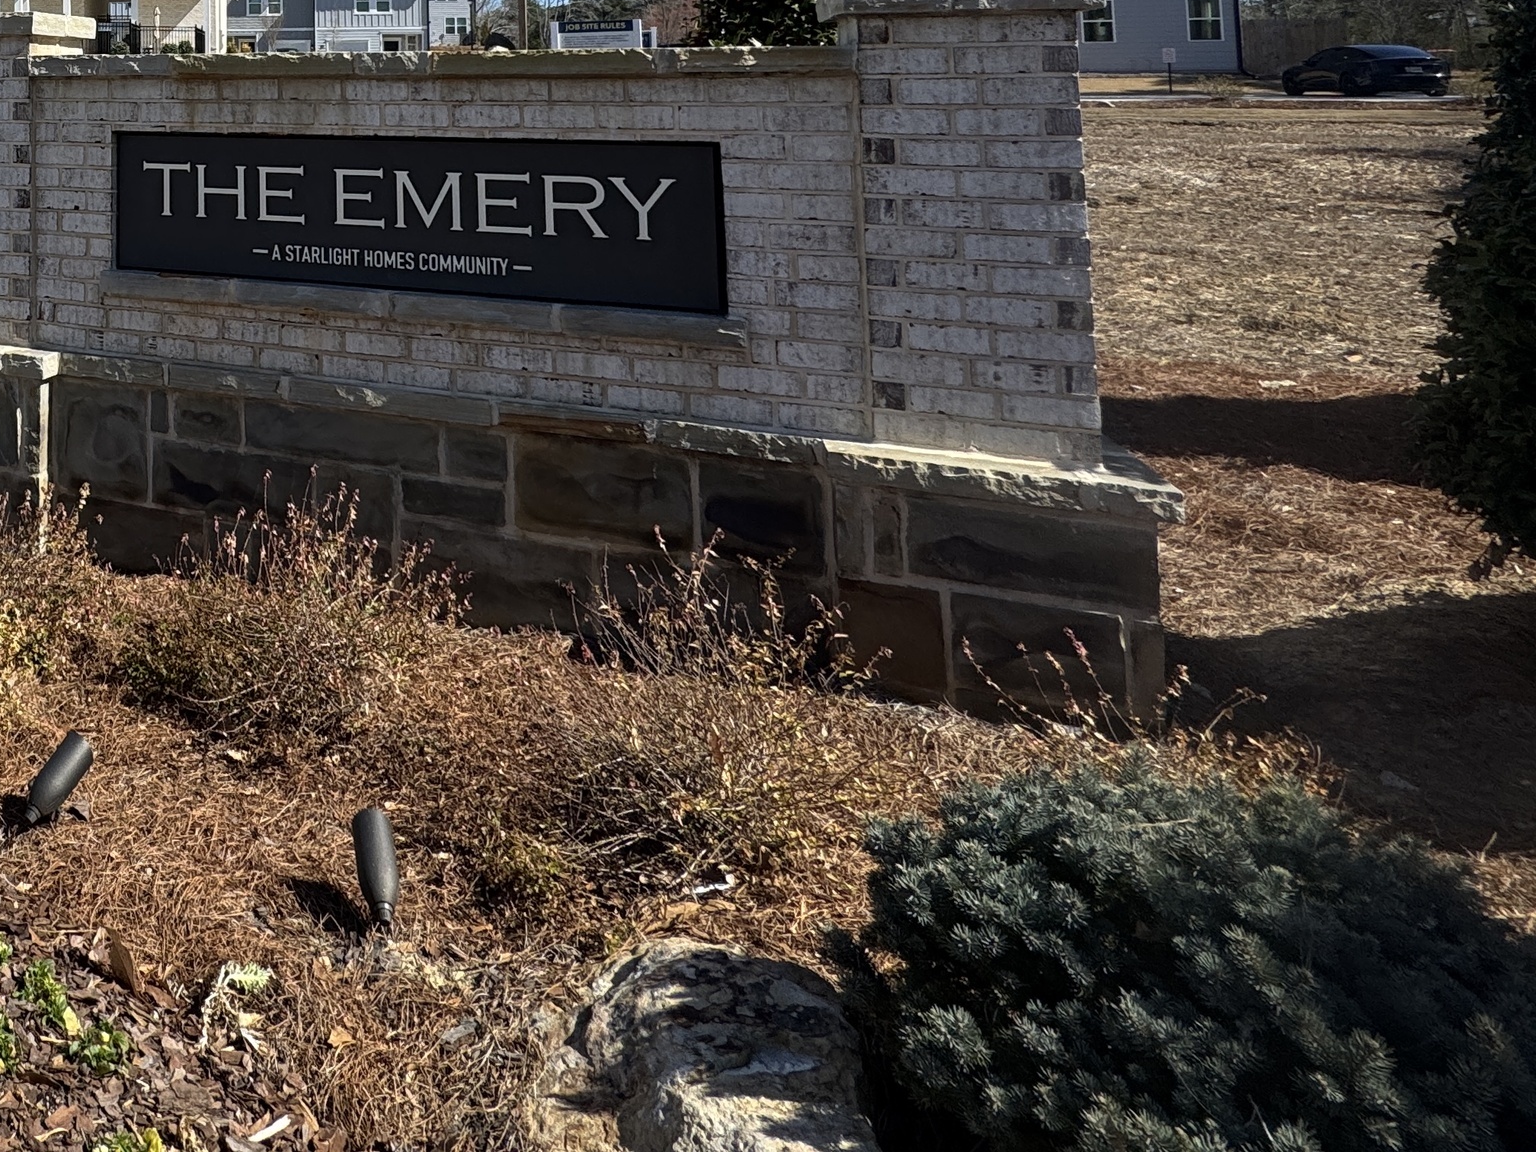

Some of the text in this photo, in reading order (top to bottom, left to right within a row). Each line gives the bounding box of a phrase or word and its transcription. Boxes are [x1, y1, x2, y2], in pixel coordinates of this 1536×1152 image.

[565, 21, 626, 32] JOB SITE RULES
[142, 160, 677, 241] THE EMERY
[271, 244, 509, 277] A STARLIGHT HOMES COMMUNITY
